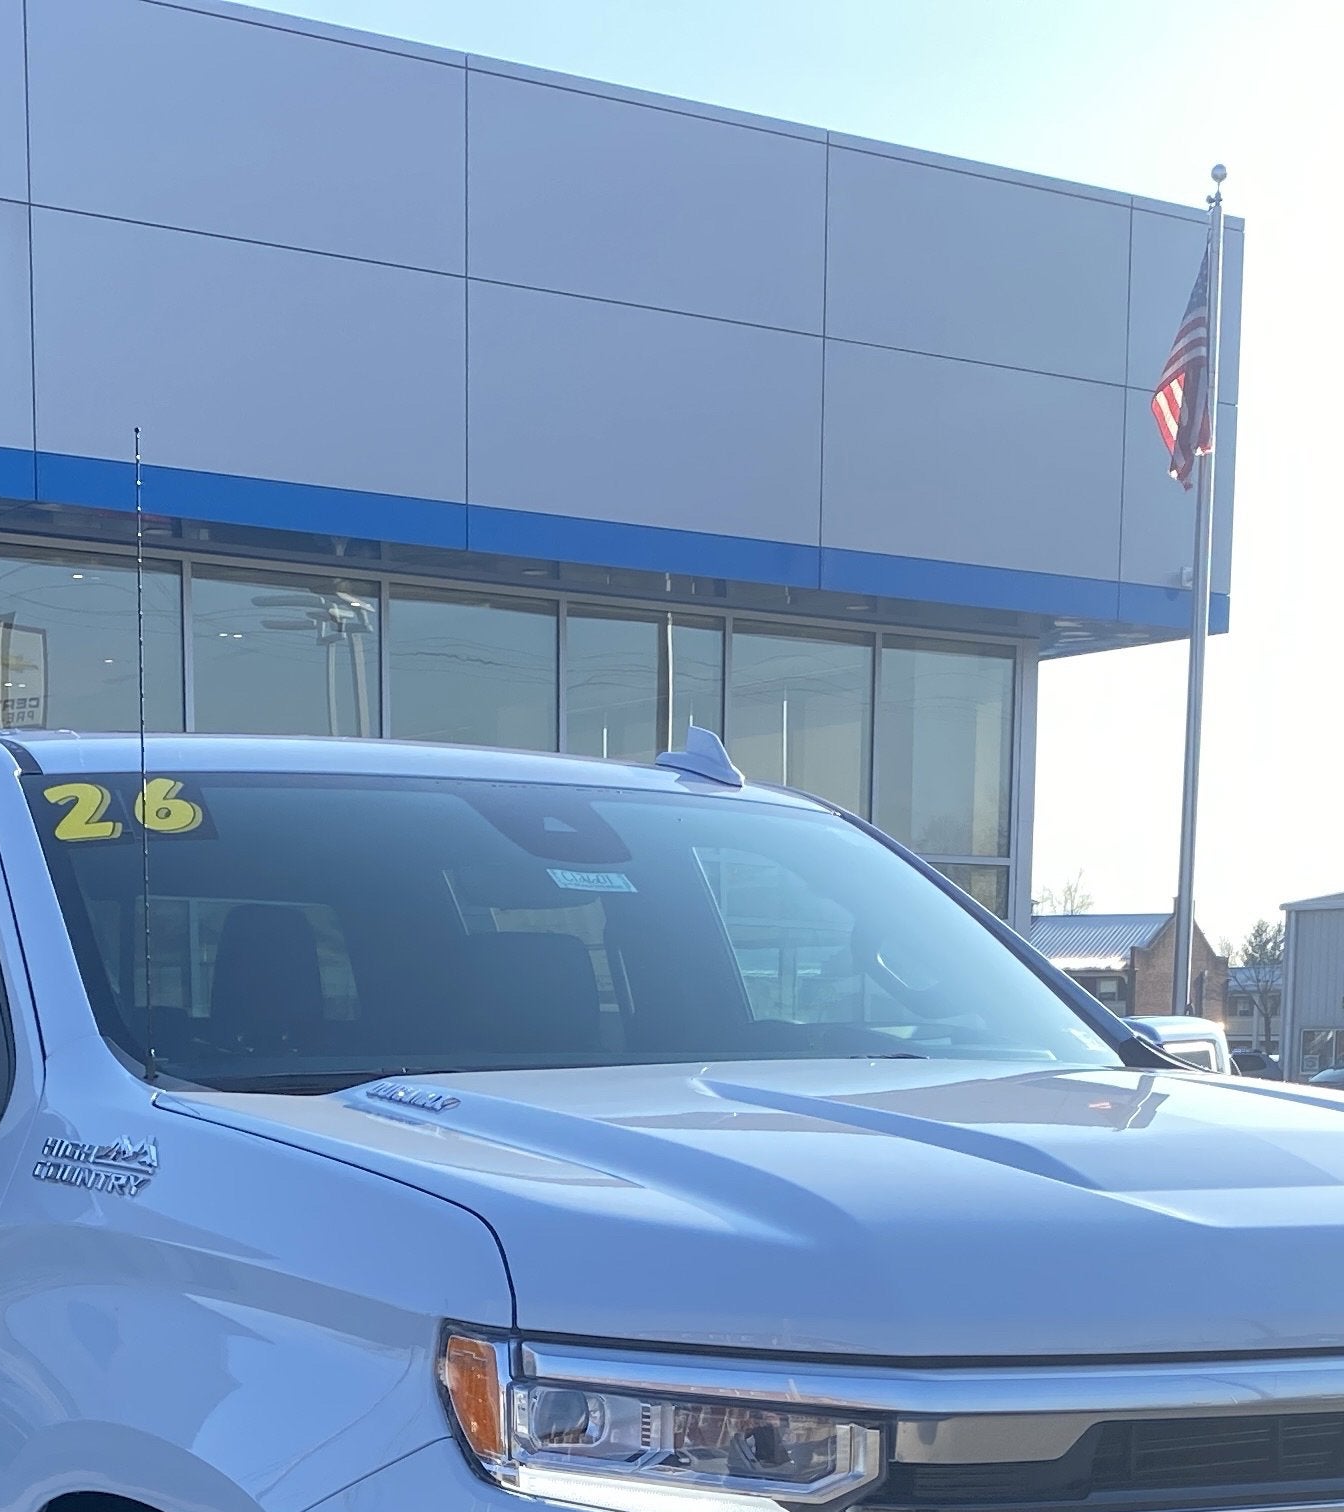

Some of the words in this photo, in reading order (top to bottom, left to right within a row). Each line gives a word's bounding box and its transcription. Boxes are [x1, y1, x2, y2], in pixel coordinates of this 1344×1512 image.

[43, 777, 203, 842] 26
[42, 1137, 98, 1163] HIGH
[33, 1161, 151, 1196] COUNTRY
